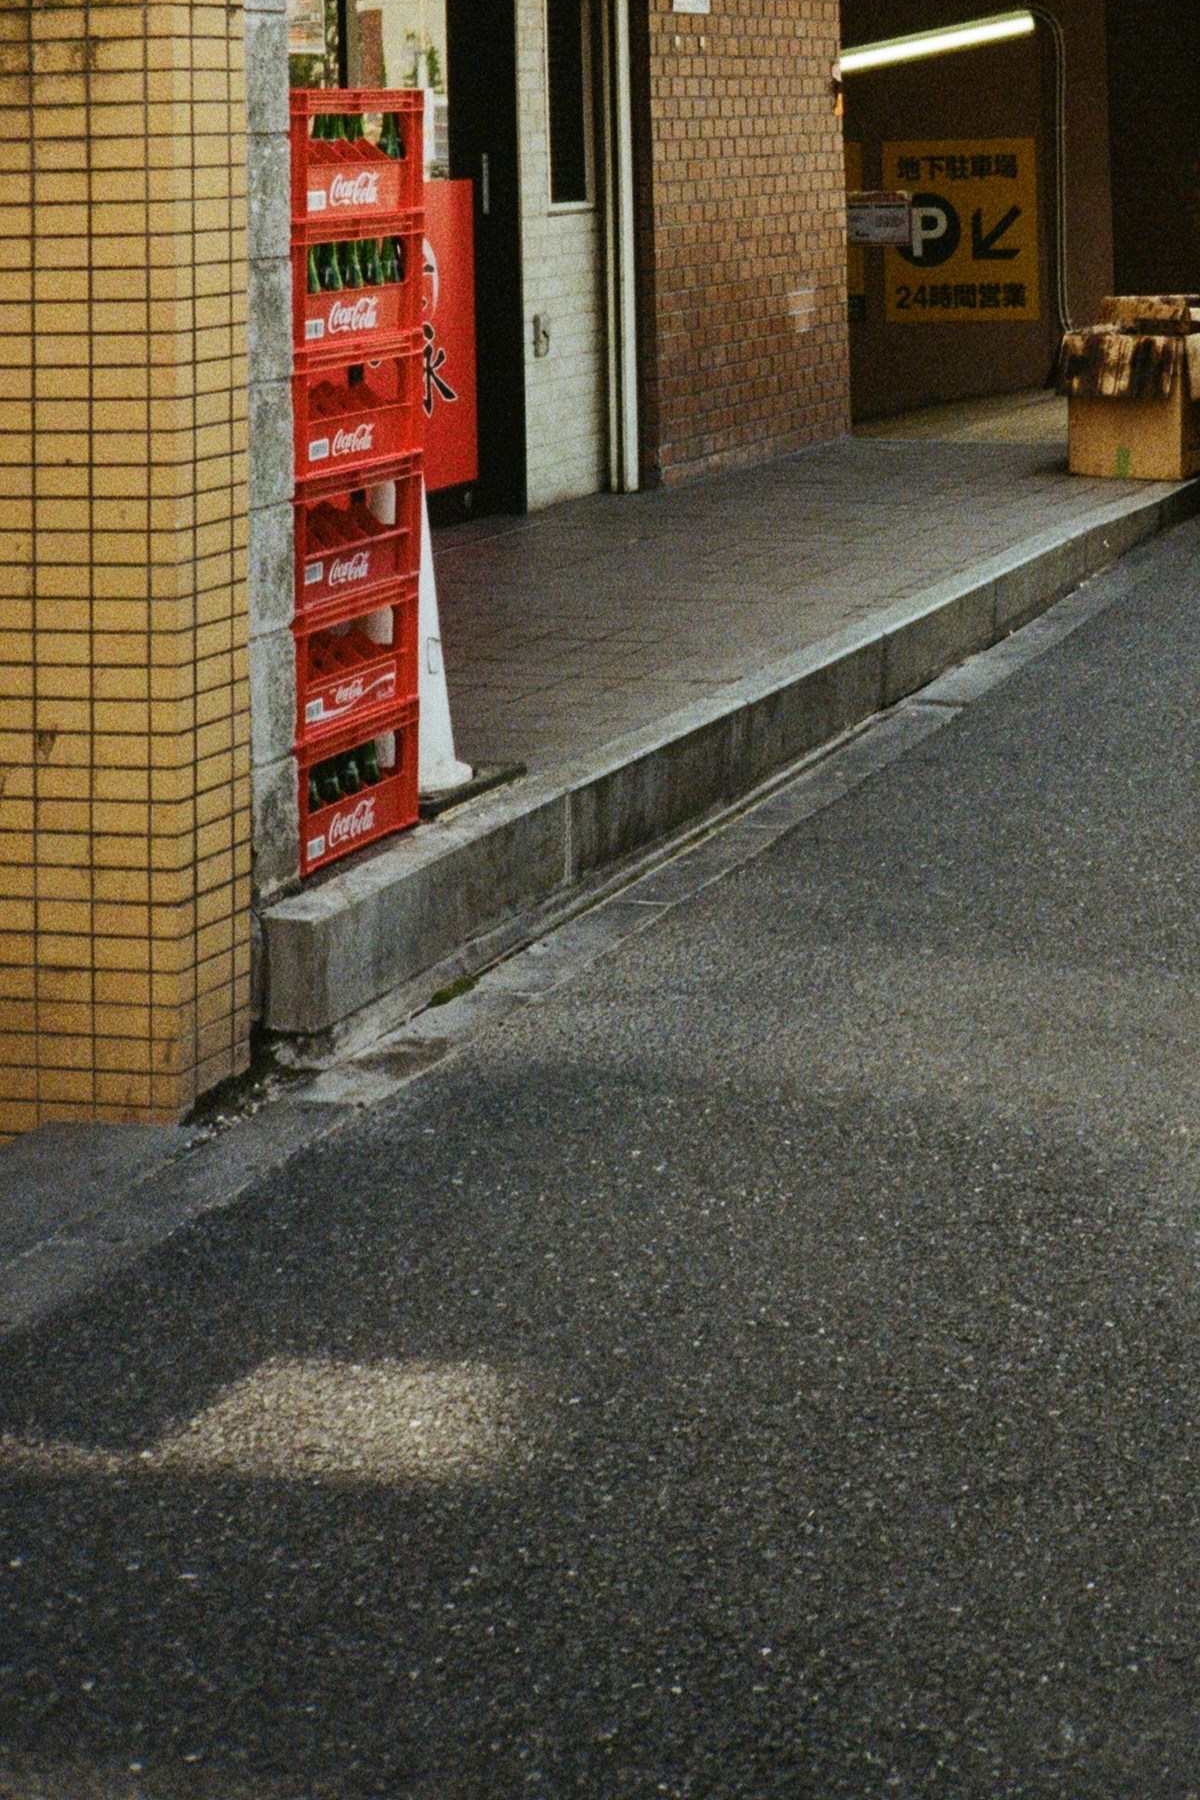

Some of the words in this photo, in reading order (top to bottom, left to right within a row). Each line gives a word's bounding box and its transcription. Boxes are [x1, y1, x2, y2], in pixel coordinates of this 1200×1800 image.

[897, 153, 1018, 181] 地下駐車場
[329, 171, 380, 207] Coca-Cola
[911, 206, 948, 258] P
[895, 283, 1028, 310] 24時間営業
[327, 298, 379, 333] Coca-Cola
[332, 423, 375, 457] Coca-Cola
[328, 550, 371, 587] Coca-Cola
[328, 797, 376, 848] Coca-Cola
